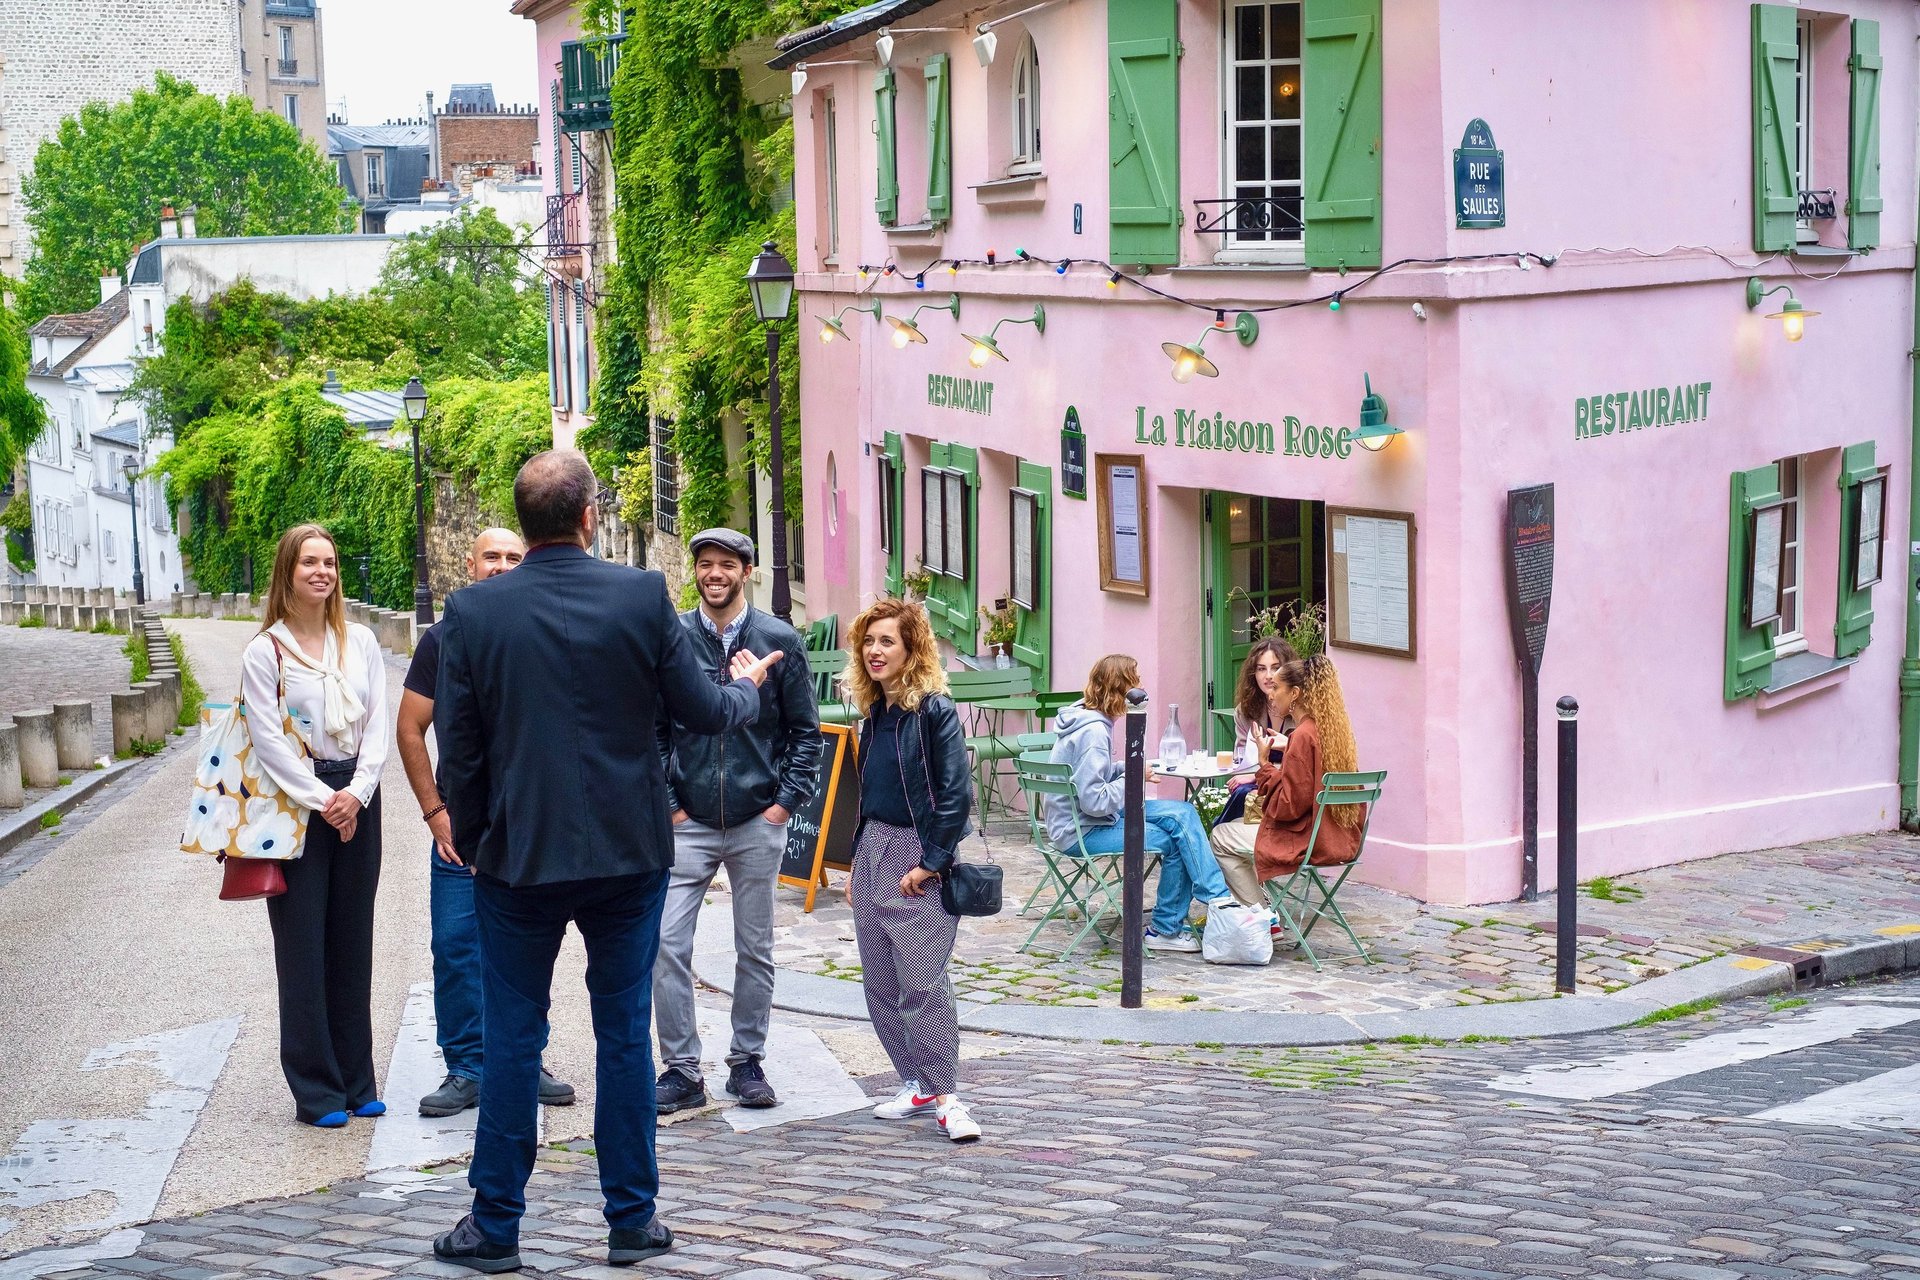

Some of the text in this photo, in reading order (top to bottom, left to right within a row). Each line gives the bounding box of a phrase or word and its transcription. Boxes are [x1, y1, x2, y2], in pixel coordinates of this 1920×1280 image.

[1470, 163, 1490, 180] RUE
[1475, 185, 1486, 193] DES
[1463, 198, 1499, 215] SAULES
[928, 373, 994, 416] RESTAURANT
[1575, 381, 1712, 440] RESTAURANT
[1135, 406, 1352, 459] La Maison Rose
